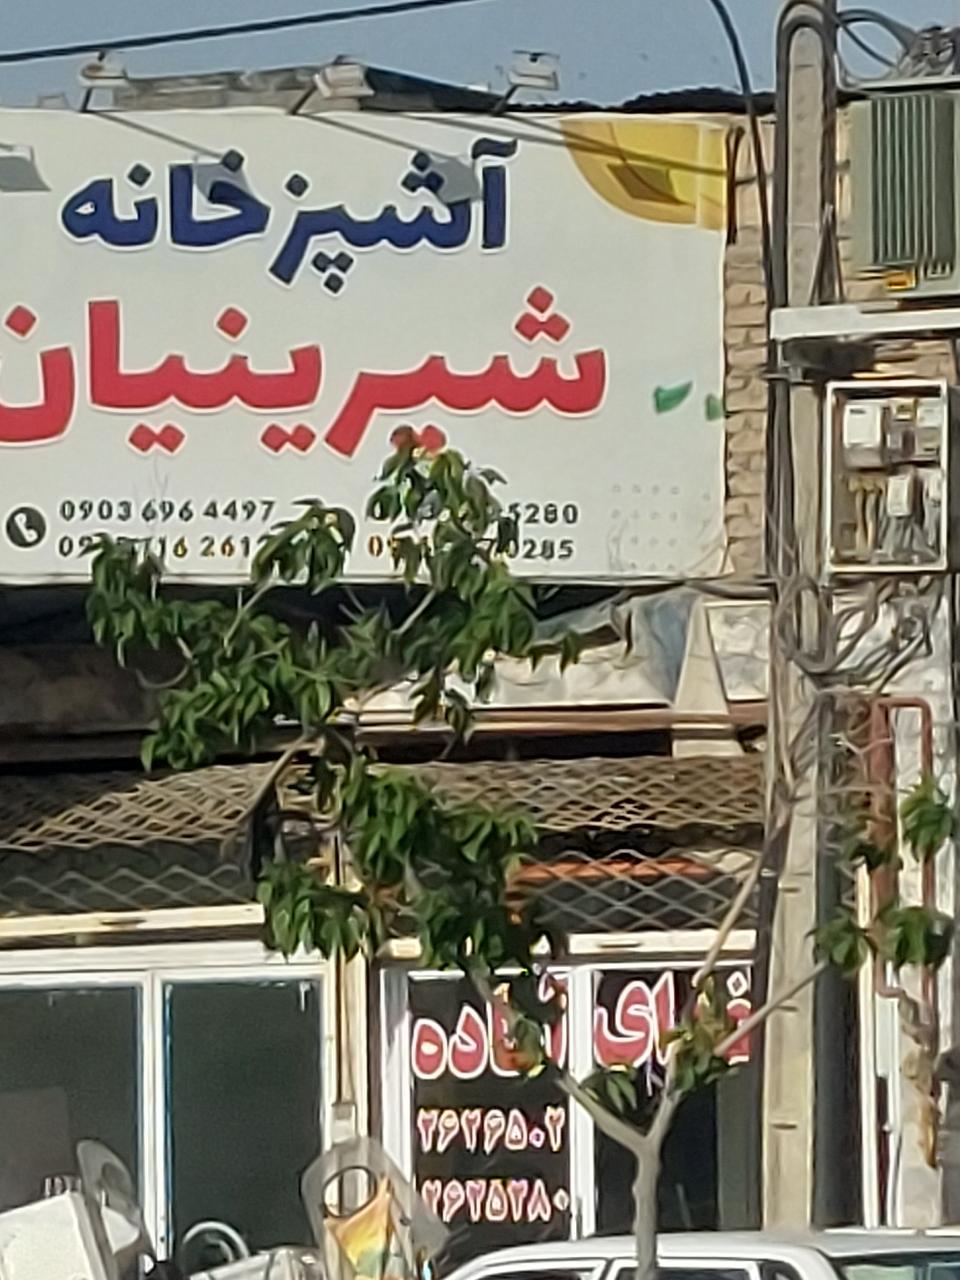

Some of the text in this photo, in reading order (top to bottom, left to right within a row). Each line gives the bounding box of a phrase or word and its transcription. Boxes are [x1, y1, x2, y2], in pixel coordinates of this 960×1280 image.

[61, 138, 517, 292] آشپزخانه
[60, 500, 275, 521] 0903 696 4497
